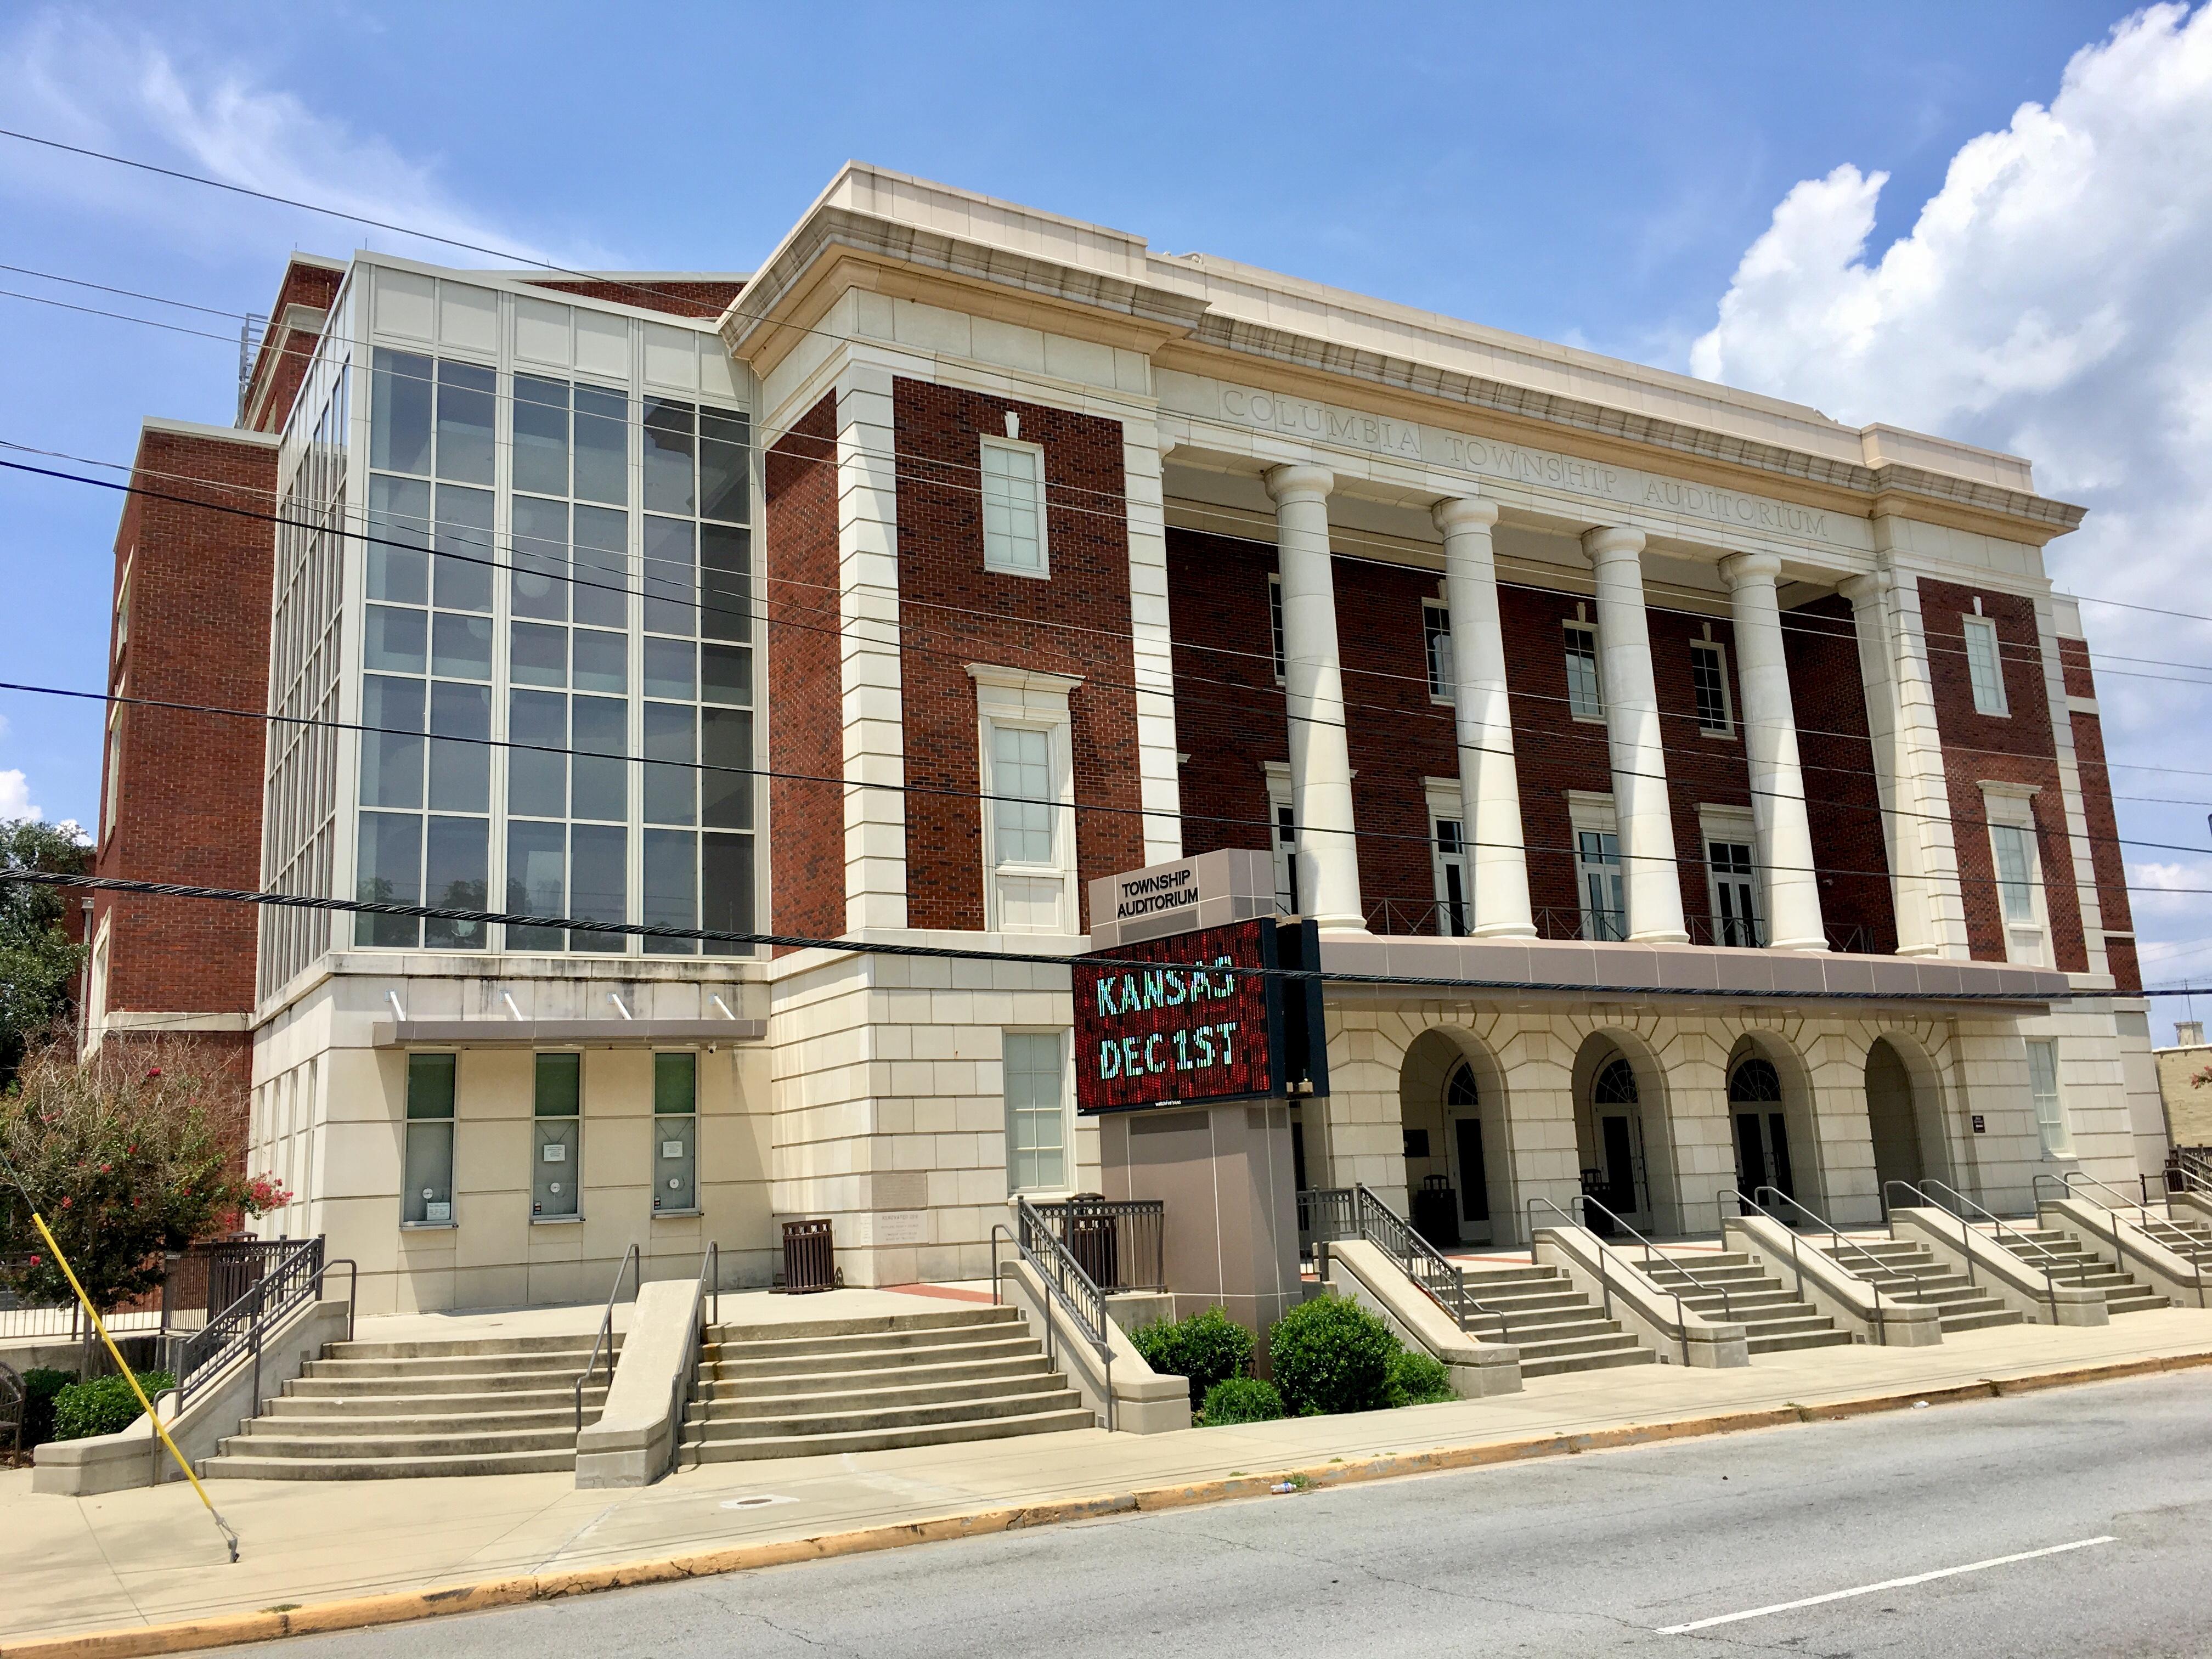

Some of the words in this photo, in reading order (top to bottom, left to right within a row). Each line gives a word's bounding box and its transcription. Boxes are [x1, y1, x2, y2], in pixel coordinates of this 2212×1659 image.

[1223, 390, 1420, 454] COLUMBIA
[1445, 437, 1617, 493] TOWNSHIP
[1644, 481, 1828, 537] AUDITORIUM
[1117, 887, 1199, 918] AUDITORIUM
[1122, 869, 1190, 898] TOWNSHIP
[1097, 955, 1235, 1017] KANSAS
[1101, 1033, 1166, 1080] DEC
[1173, 1022, 1237, 1070] 1ST
